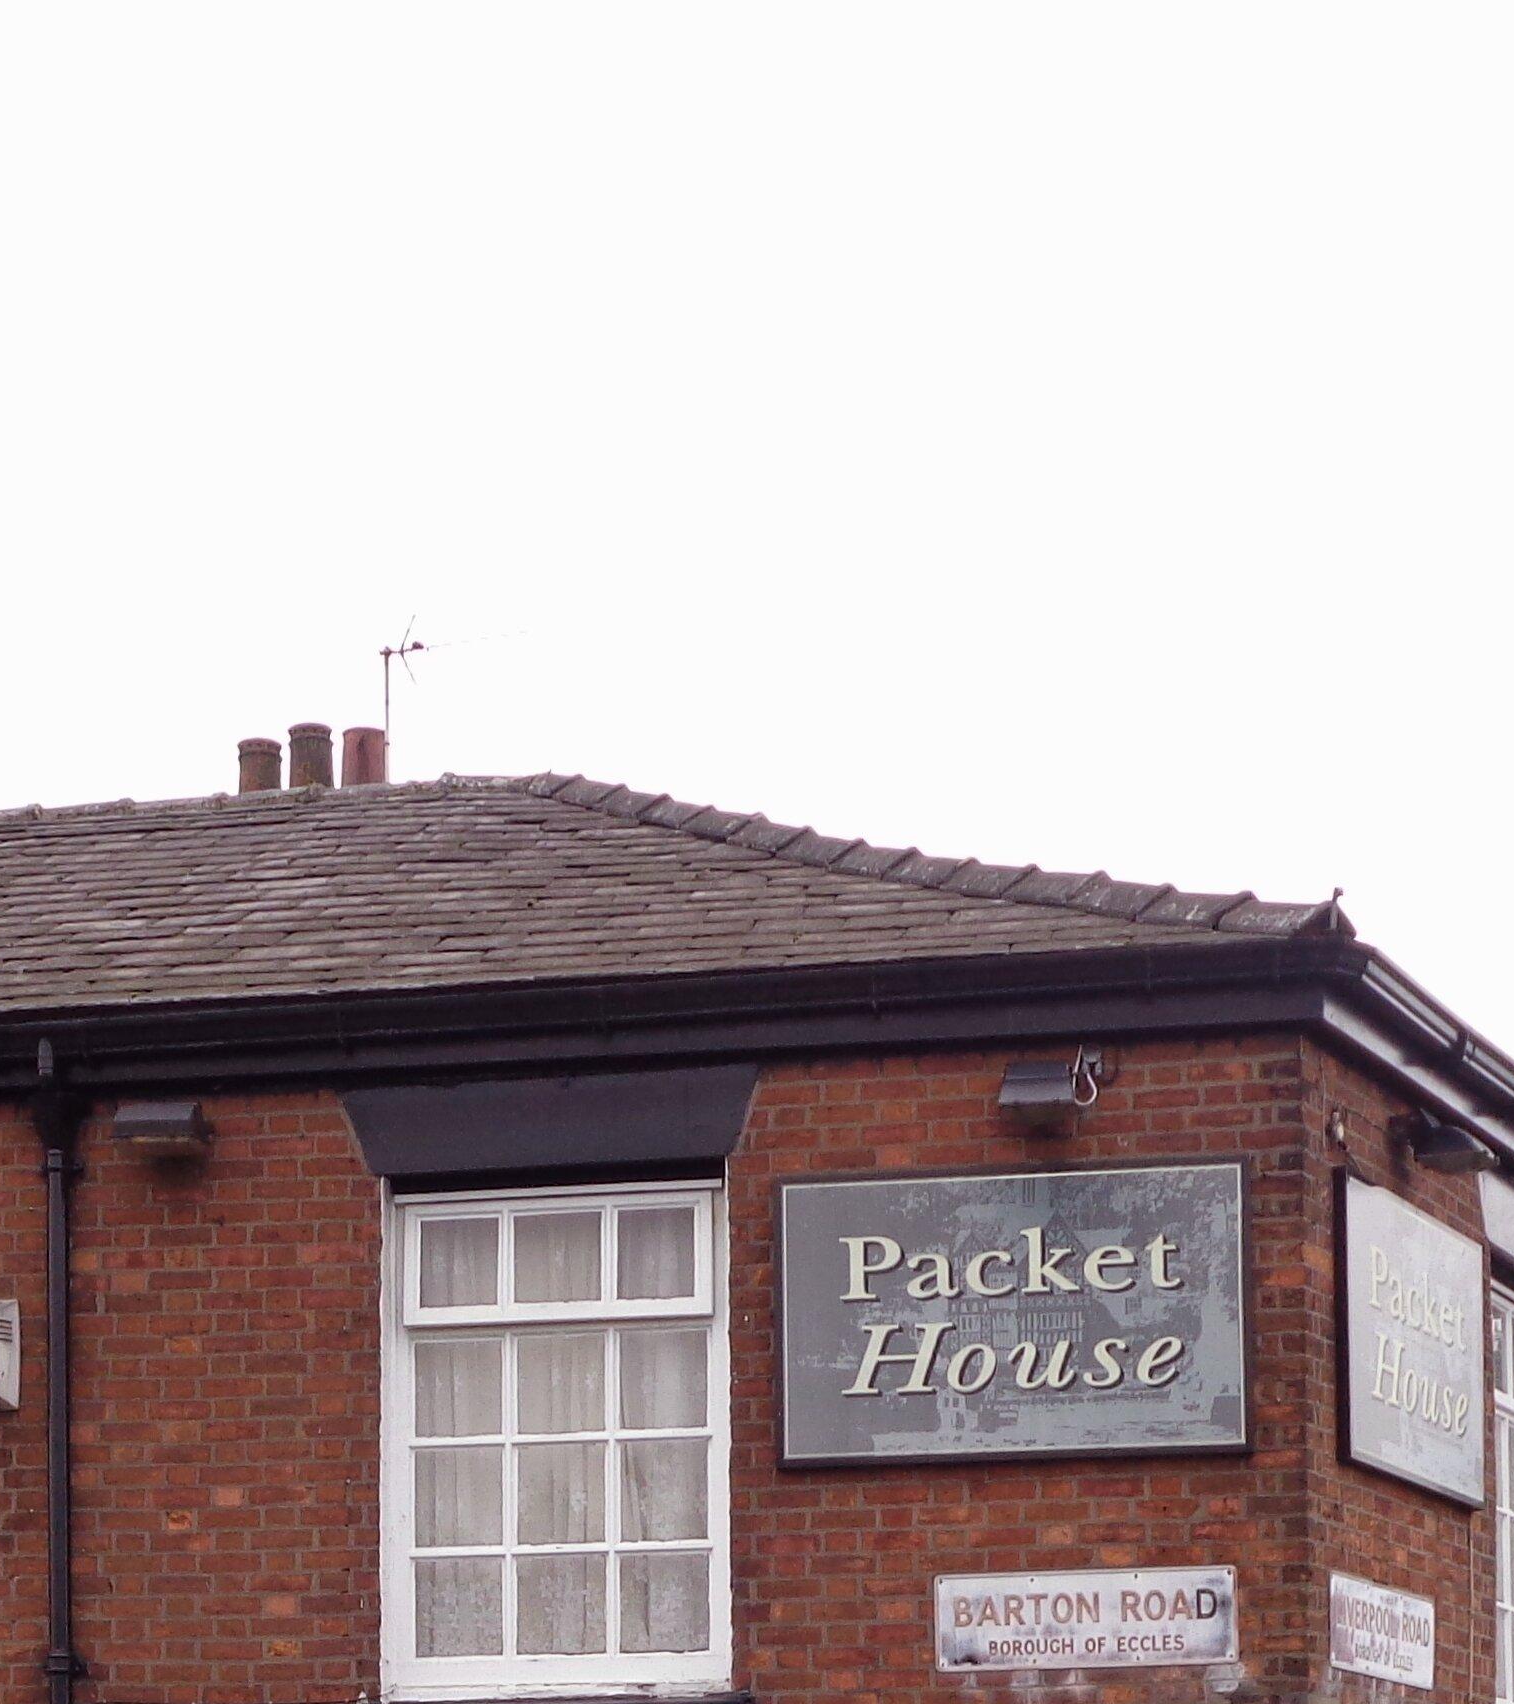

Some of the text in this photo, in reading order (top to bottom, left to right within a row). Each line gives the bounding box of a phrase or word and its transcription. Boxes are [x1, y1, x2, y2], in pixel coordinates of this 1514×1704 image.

[839, 1226, 1183, 1302] Packet
[1369, 1245, 1466, 1351] Packet
[841, 1321, 1185, 1397] House
[1372, 1332, 1469, 1438] House
[953, 1588, 1218, 1628] BARTON ROAD
[988, 1633, 1185, 1655] BOROUGH OF ECCLES
[1401, 1612, 1431, 1648] ROAD
